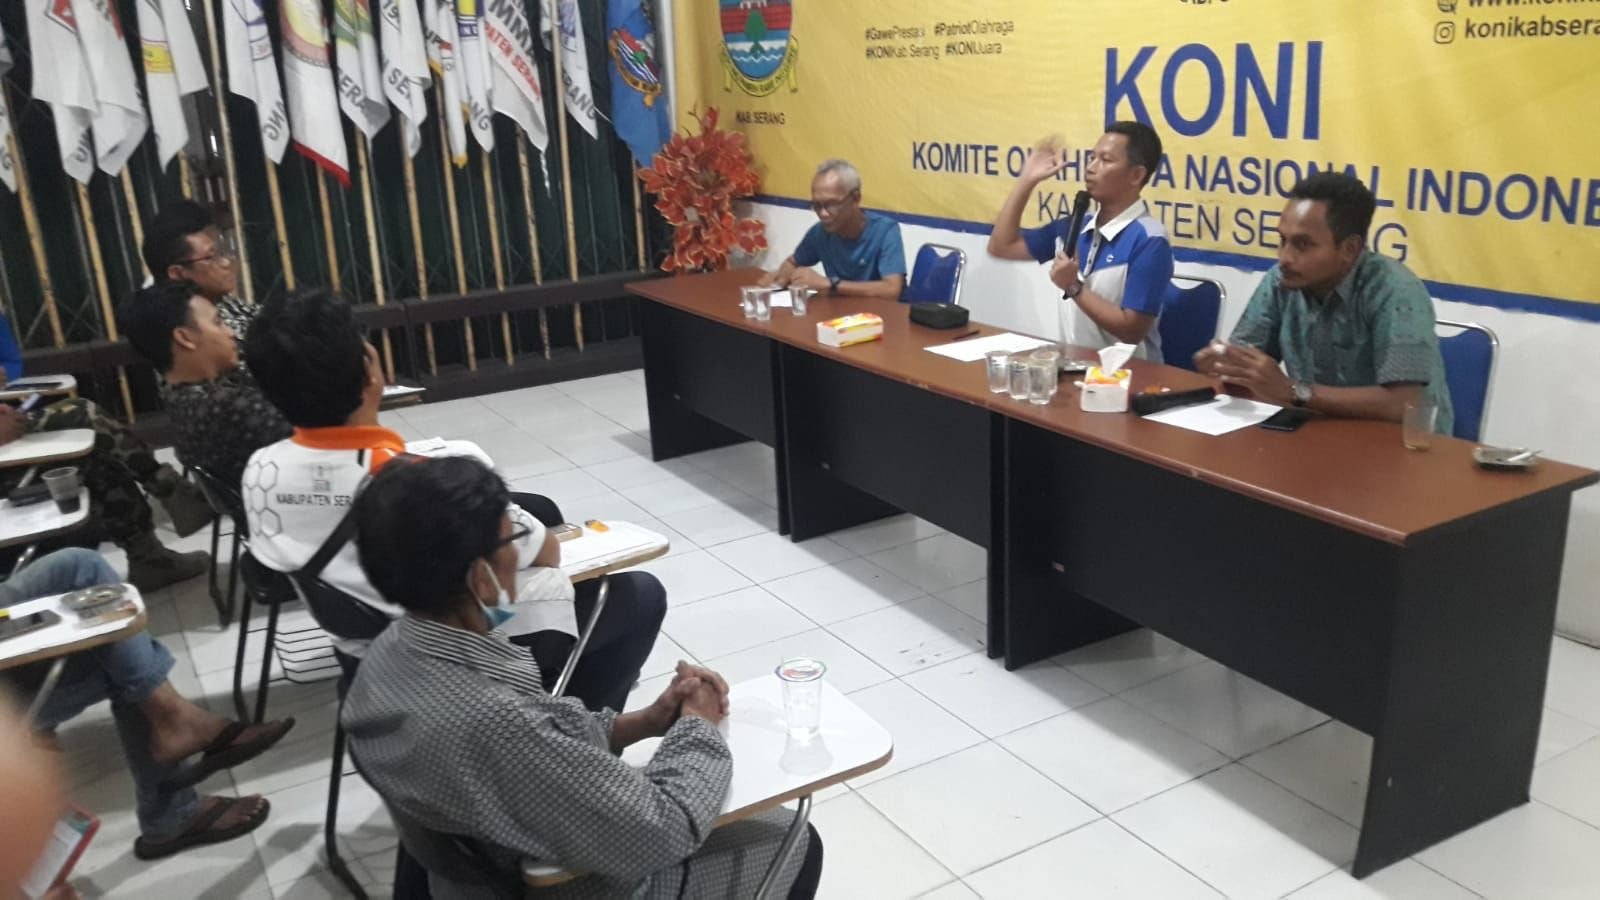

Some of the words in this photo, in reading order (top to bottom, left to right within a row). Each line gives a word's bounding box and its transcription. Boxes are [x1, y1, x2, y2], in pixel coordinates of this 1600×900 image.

[934, 20, 1015, 36] #PatriotOlahraga
[1104, 41, 1323, 141] KONI
[753, 111, 785, 125] SERANG
[912, 141, 999, 176] KOMITE
[1406, 167, 1600, 227] INDONE
[276, 493, 331, 506] KABUPATEN
